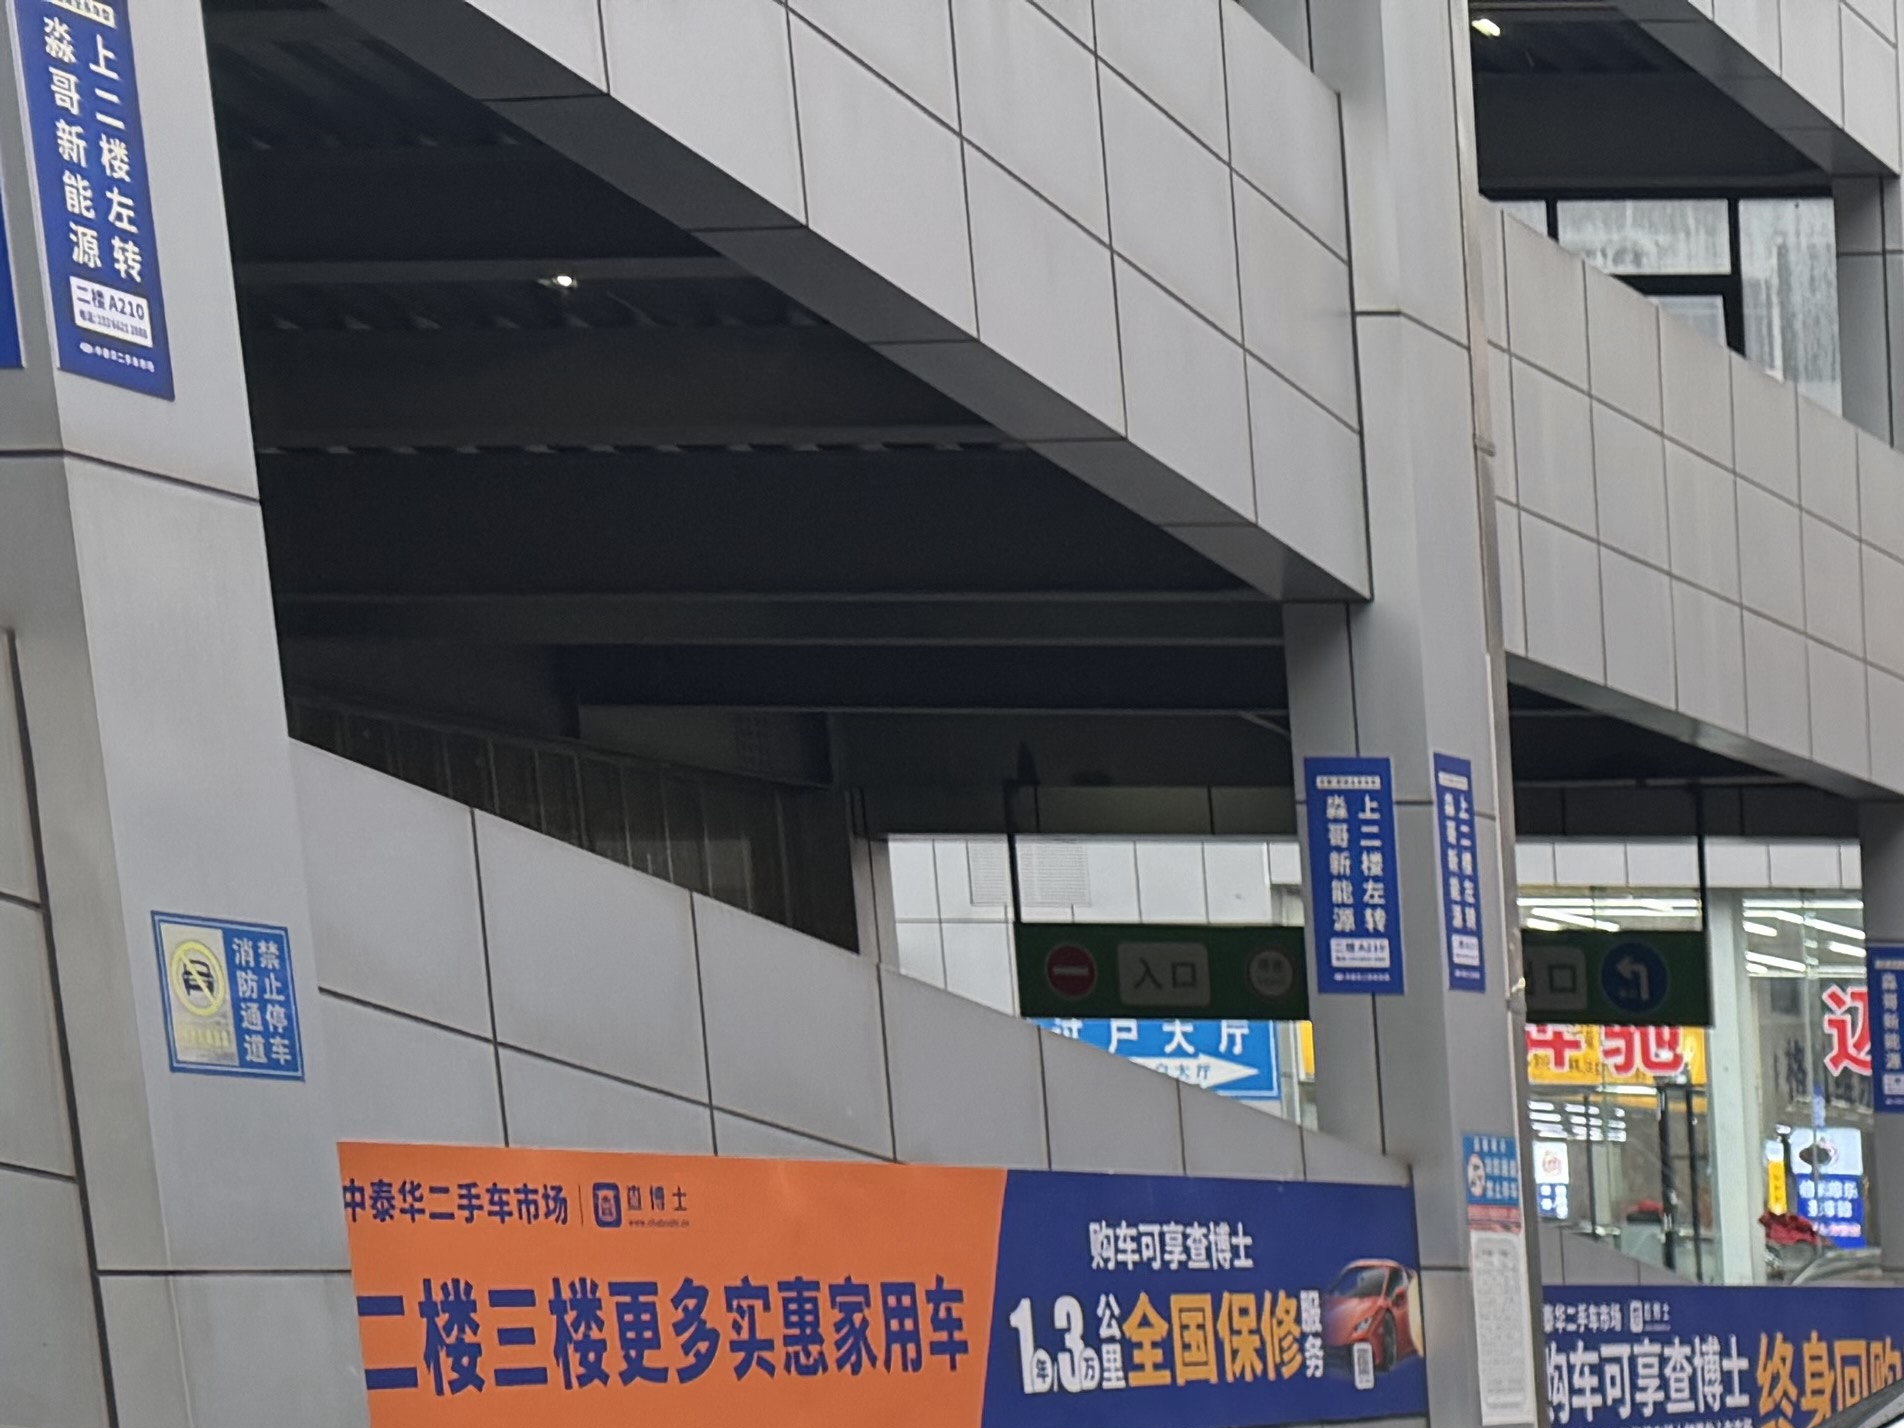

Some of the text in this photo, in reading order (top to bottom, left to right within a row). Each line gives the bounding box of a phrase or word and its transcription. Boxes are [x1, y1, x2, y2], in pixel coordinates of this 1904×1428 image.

[44, 17, 102, 268] 淼哥新能源
[89, 34, 142, 282] 上二楼左转
[109, 295, 145, 320] A210
[1358, 793, 1387, 933] 上二楼左转
[232, 937, 268, 1064] 消防通道
[258, 940, 292, 1066] 禁止停车
[1134, 958, 1197, 990] 入口
[342, 1179, 569, 1225] 中泰华二手车市场
[1089, 1220, 1254, 1270] 购车可享查博士
[356, 1275, 969, 1397] 二楼三楼更多实惠家用车
